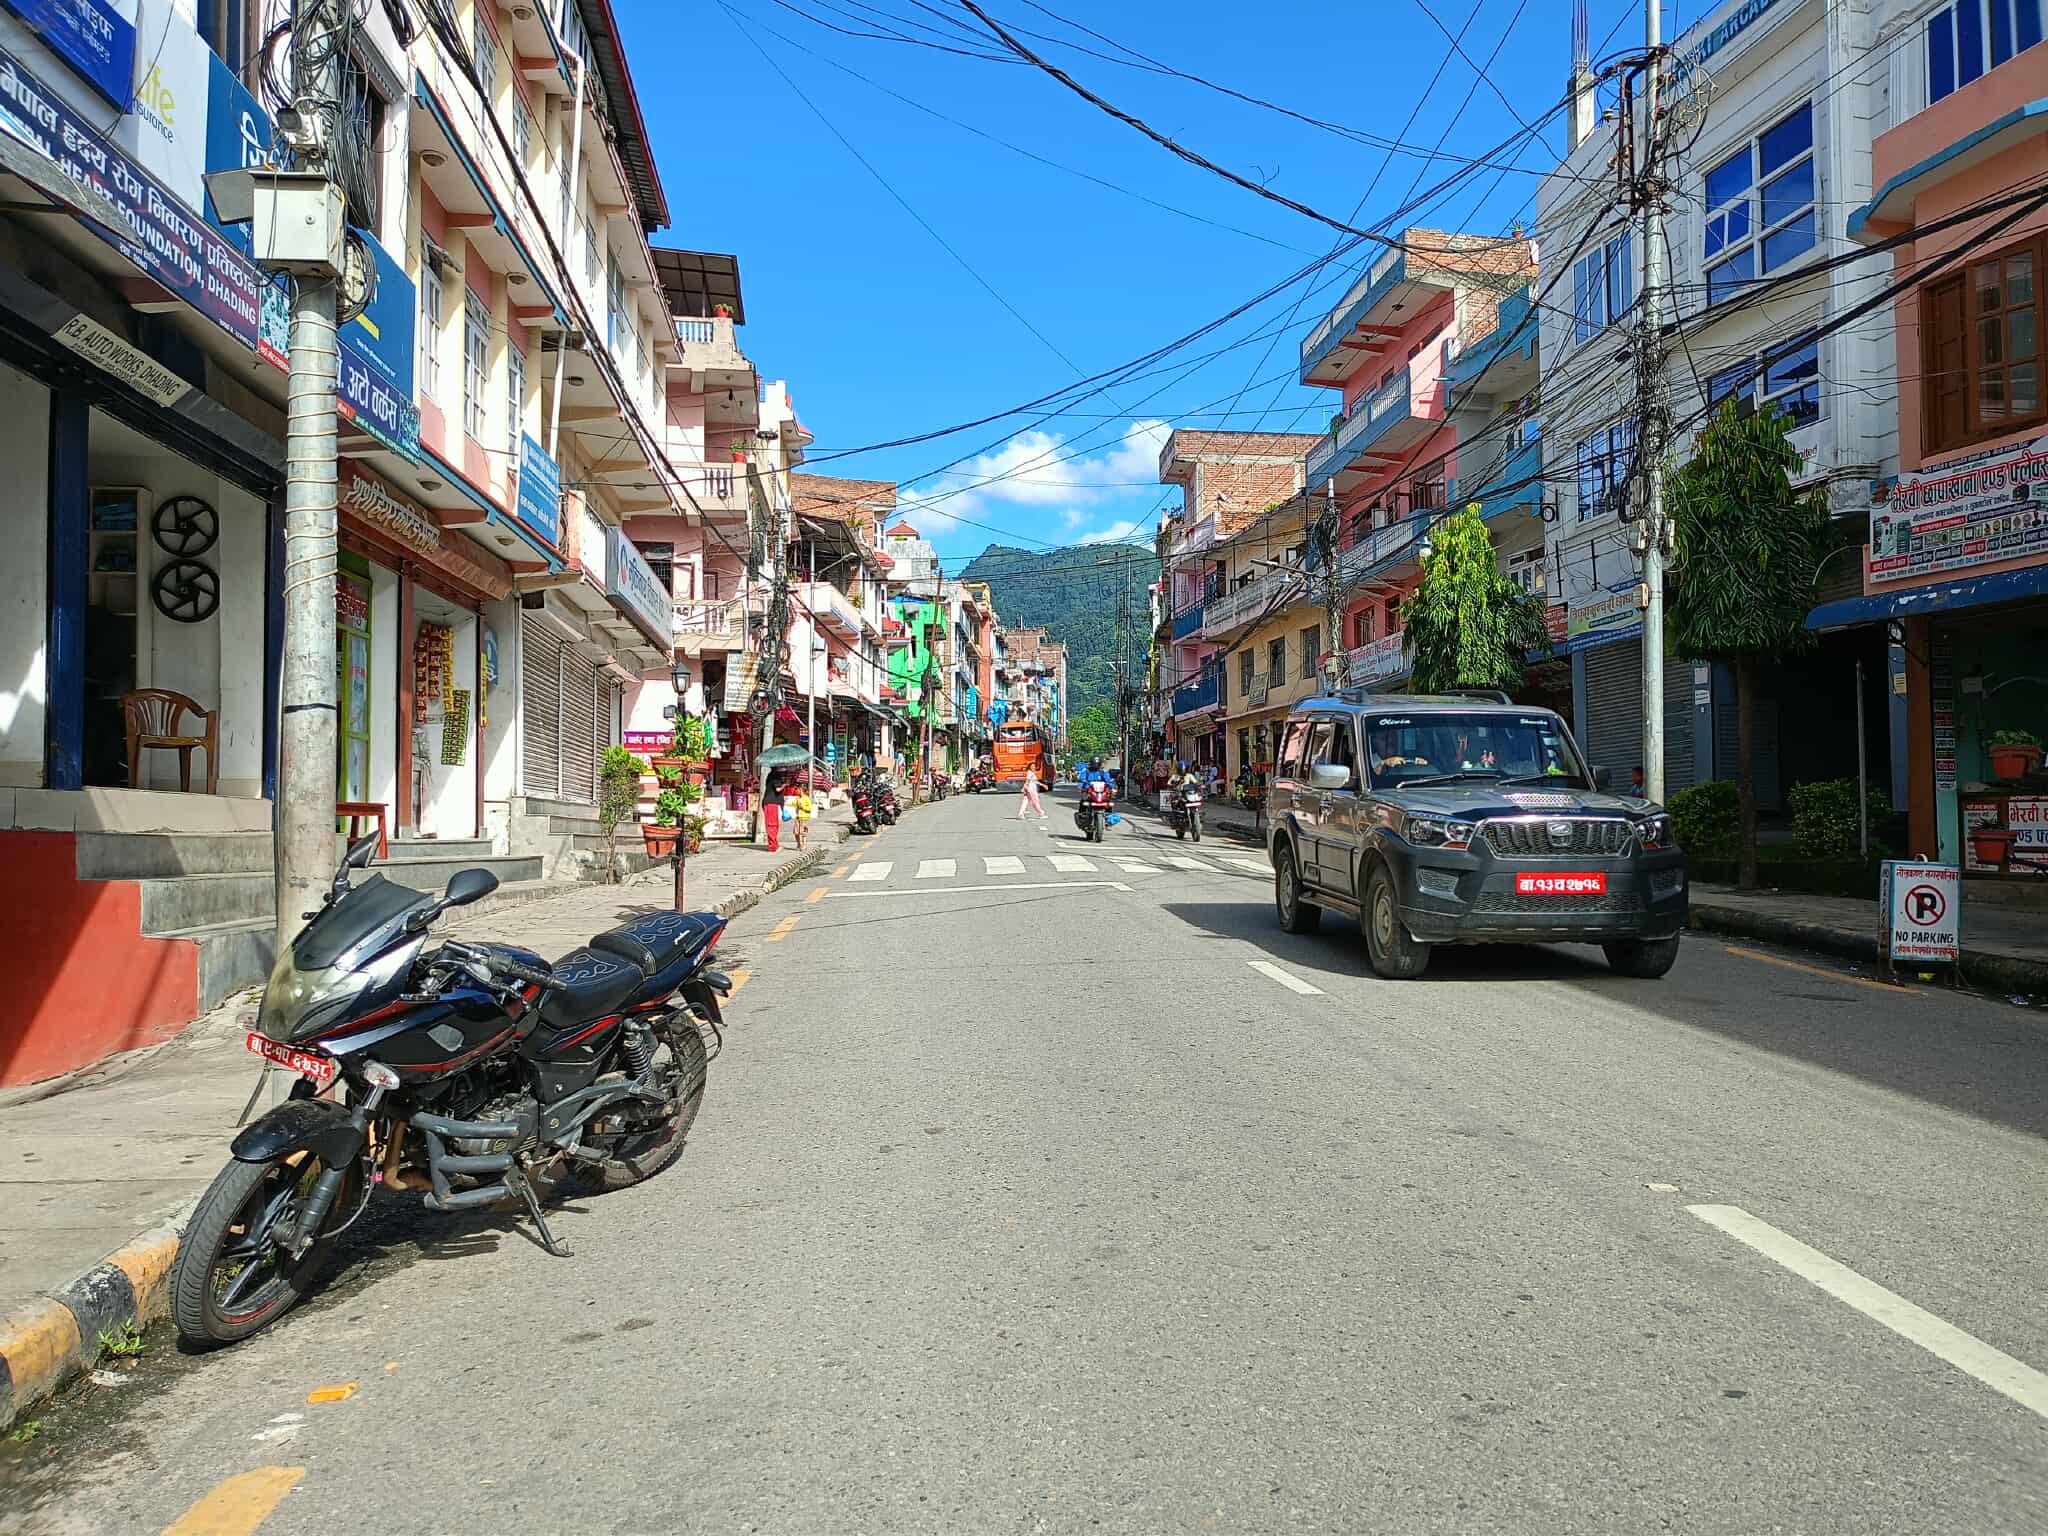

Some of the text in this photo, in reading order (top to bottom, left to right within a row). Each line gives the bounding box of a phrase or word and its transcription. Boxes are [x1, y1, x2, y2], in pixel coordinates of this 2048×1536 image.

[133, 99, 173, 143] nsurance
[64, 119, 108, 176] हृदय
[112, 160, 144, 205] रोग
[148, 187, 204, 254] निवारण
[207, 240, 258, 299] प्रतिष्ठान
[208, 274, 256, 324] DHADING
[84, 331, 114, 357] AUTO
[139, 366, 181, 396] DHADING
[1890, 479, 1921, 512] भैरवी
[1921, 468, 1979, 507] छापाखाना
[1980, 462, 2009, 493] एण्ड
[1895, 930, 1954, 945] NO PARKING
